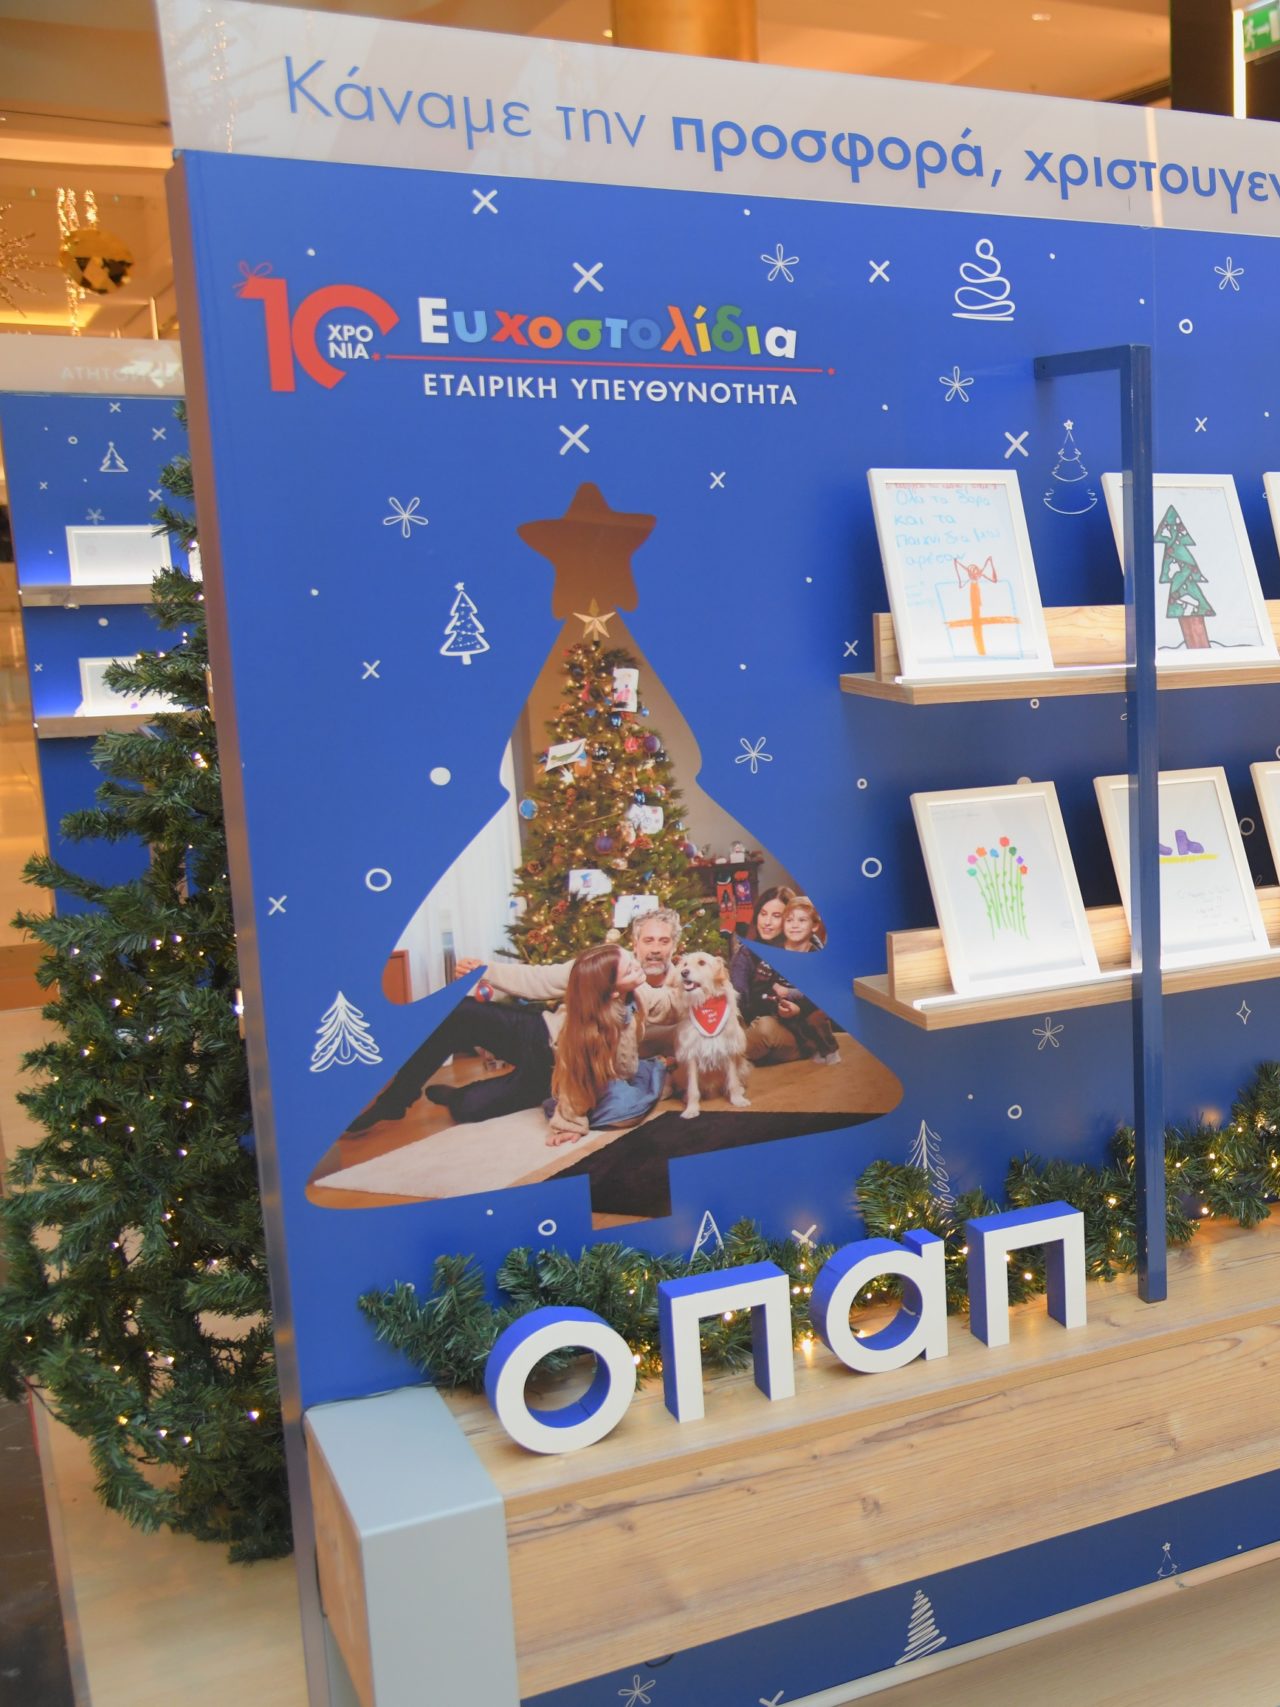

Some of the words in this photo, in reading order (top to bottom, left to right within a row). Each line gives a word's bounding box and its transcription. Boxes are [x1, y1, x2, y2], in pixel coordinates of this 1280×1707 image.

[284, 55, 533, 151] Κάναμε
[556, 104, 647, 148] την
[671, 115, 1002, 189] προσφορά,
[417, 296, 798, 360] Ευχοστολίδια
[422, 373, 558, 399] ΕΤΑΙΡΙΚΗ
[570, 377, 798, 406] ΥΠΕΥΘΥΝΟΤΗΤΑ
